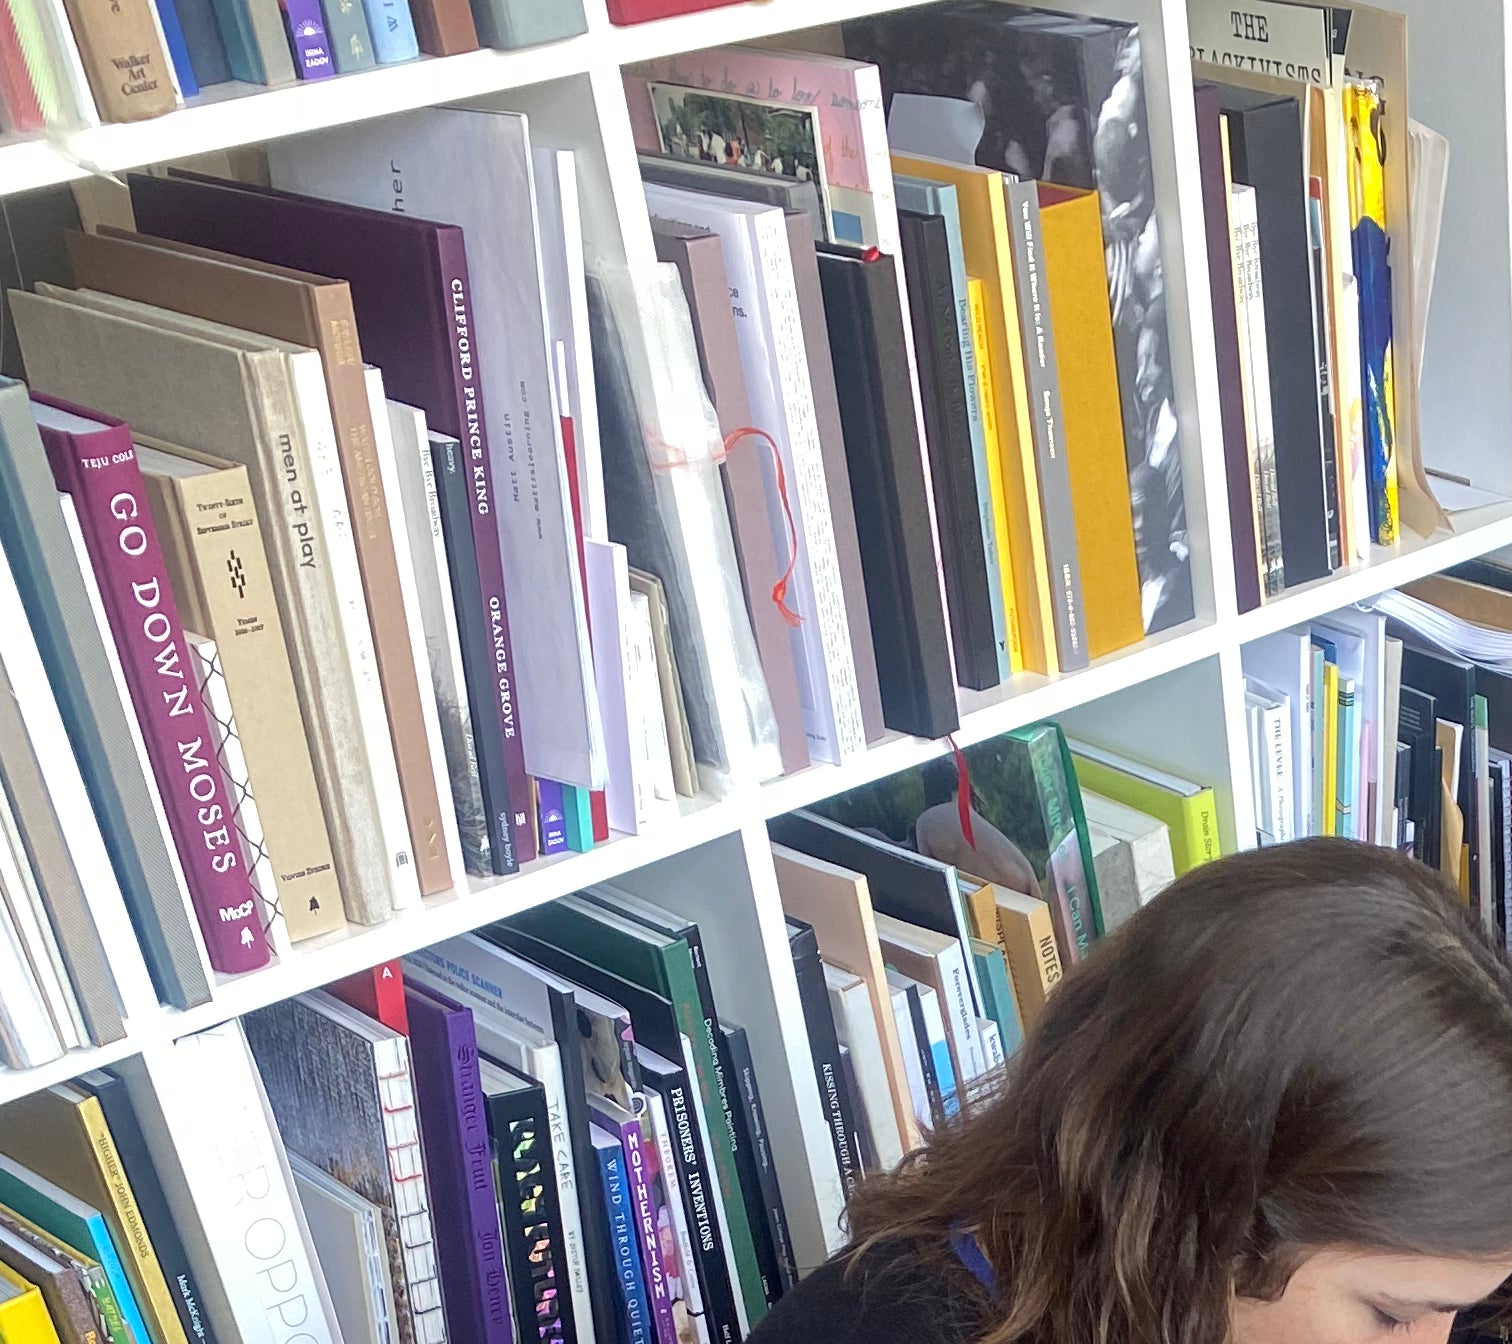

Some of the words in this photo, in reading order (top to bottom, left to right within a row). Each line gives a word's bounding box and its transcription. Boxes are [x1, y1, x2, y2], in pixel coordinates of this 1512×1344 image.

[1231, 11, 1269, 42] THE
[111, 53, 151, 71] Walker
[128, 67, 146, 81] Art
[121, 79, 158, 96] Center
[82, 455, 109, 469] TEJU
[112, 449, 134, 464] COLE
[280, 433, 297, 482] men
[292, 490, 307, 514] at
[451, 279, 473, 380] CLIFFORD
[463, 386, 482, 460] PRINCE
[473, 465, 489, 515] KING
[489, 597, 507, 673] ORANGE
[499, 677, 515, 738] GROVE
[293, 522, 317, 569] play
[110, 492, 147, 556] GO
[132, 576, 194, 717] DOWN
[177, 736, 237, 874] MOSES
[1039, 935, 1060, 984] NOTES
[547, 1097, 565, 1144] TAKE
[822, 1063, 839, 1109] KISSING
[832, 1109, 851, 1165] THROUGH
[554, 1148, 573, 1191] CARE
[607, 1159, 622, 1205] WIND
[115, 1182, 130, 1208] JOHN
[126, 1205, 150, 1258] EDMONDS
[628, 1133, 664, 1299] MOTHERNISM
[689, 1172, 713, 1251] INVENTIONS
[614, 1212, 635, 1290] THROUGH
[177, 1274, 191, 1298] Mark
[185, 1296, 204, 1338] McKnight
